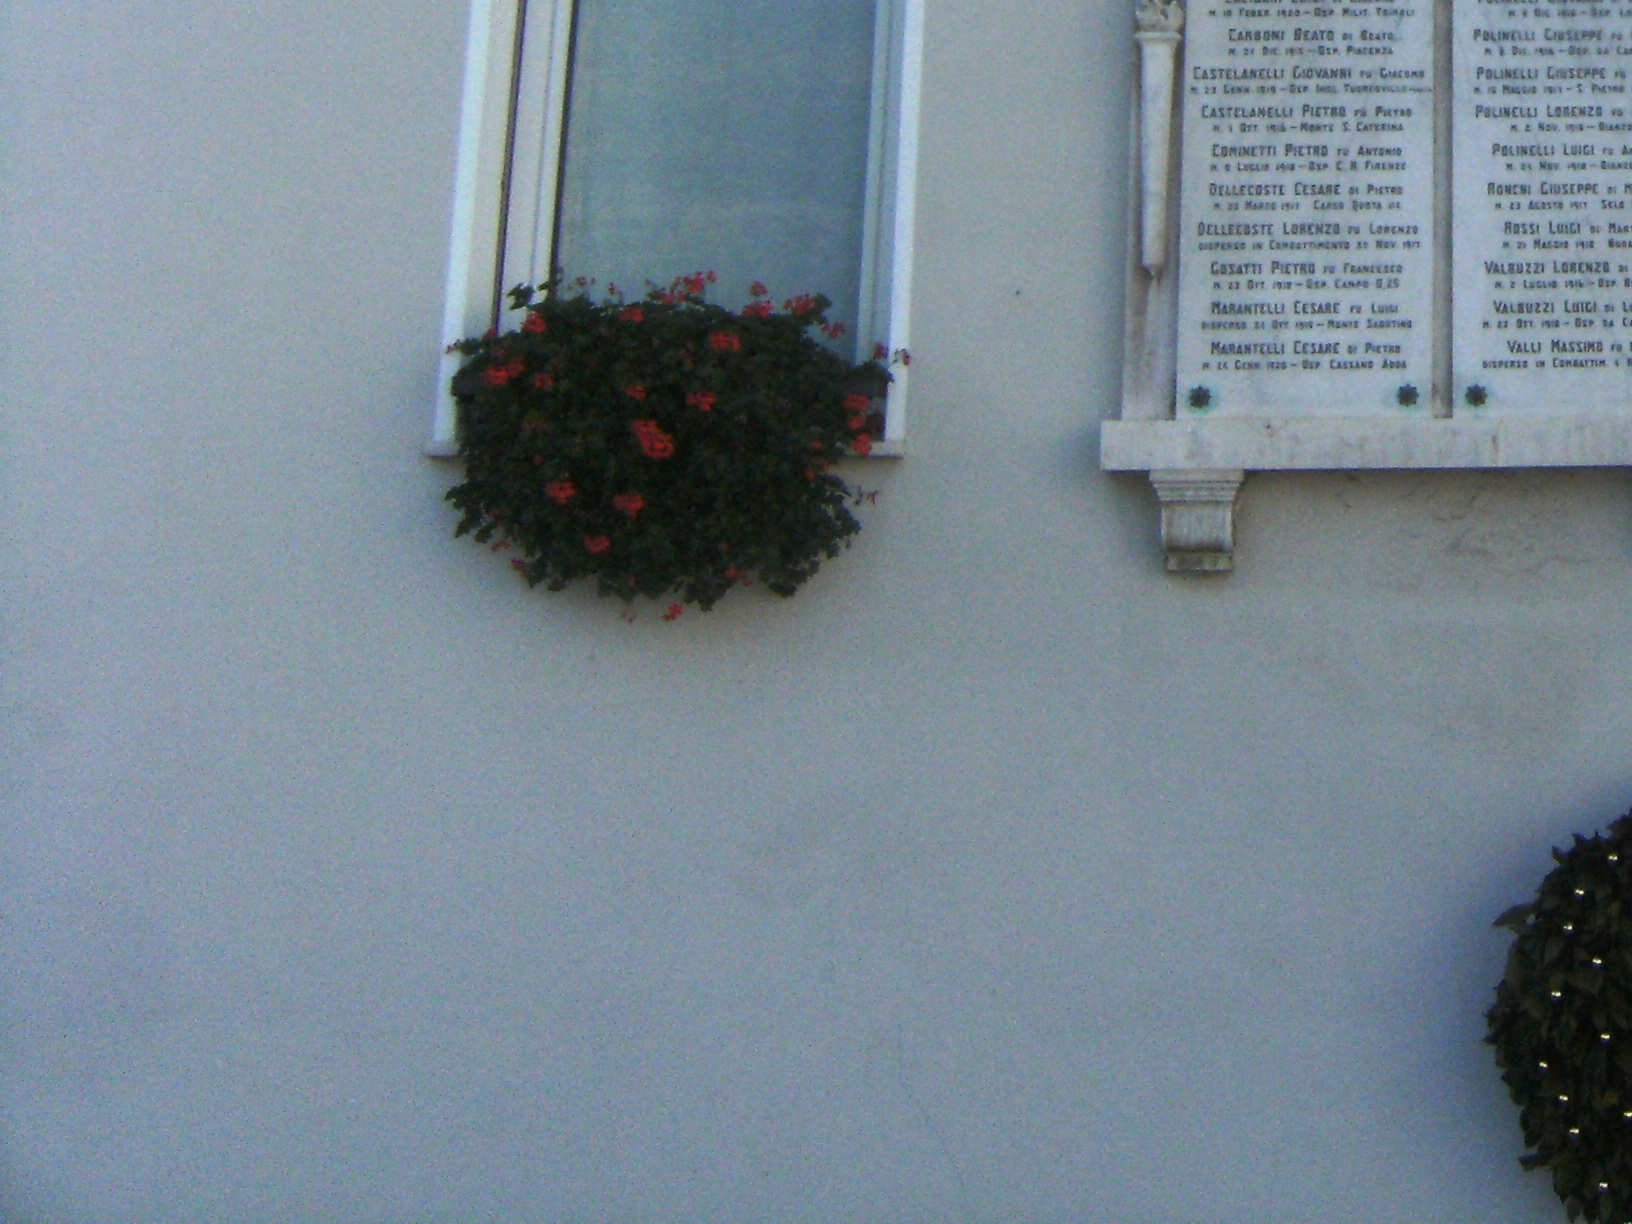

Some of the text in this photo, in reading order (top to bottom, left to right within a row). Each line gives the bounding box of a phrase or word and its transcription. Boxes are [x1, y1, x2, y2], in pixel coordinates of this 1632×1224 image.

[1547, 106, 1602, 118] LORENZO
[1492, 143, 1594, 156] POLINELLI LUIGI
[1540, 182, 1598, 195] GIUSEPPE
[1549, 221, 1581, 235] LUIGI
[1271, 261, 1315, 274] PIETRO
[1553, 262, 1609, 273] LORENZO
[1564, 301, 1597, 313] LUIGI
[1507, 341, 1541, 353] VALLI
